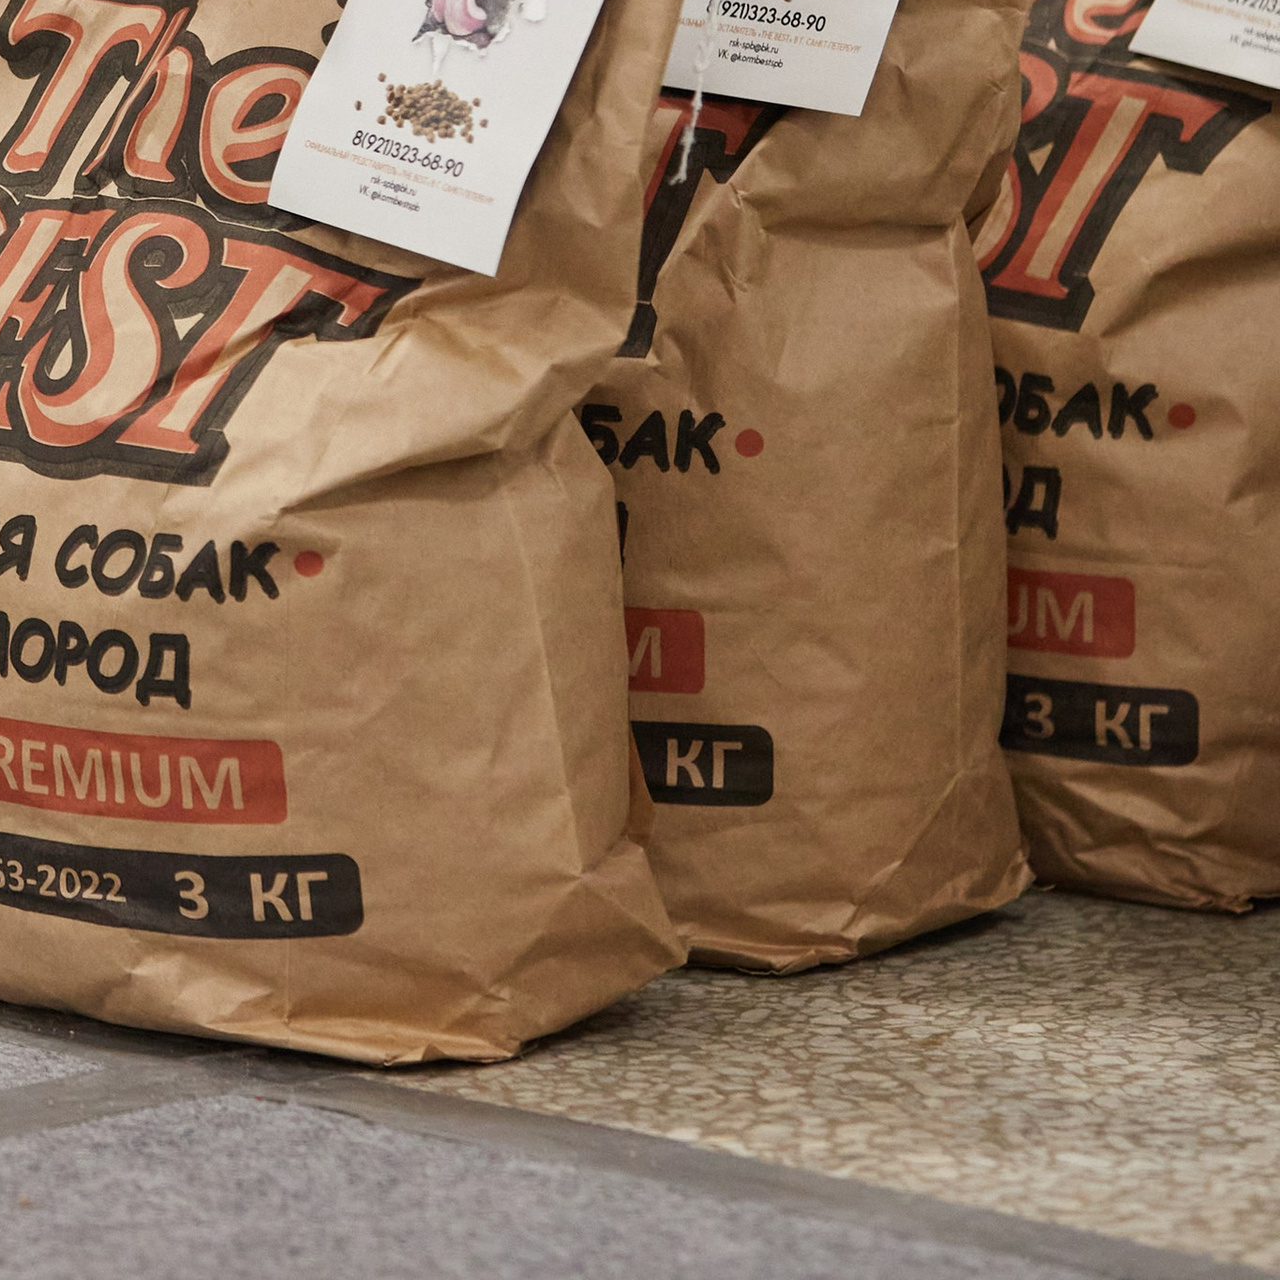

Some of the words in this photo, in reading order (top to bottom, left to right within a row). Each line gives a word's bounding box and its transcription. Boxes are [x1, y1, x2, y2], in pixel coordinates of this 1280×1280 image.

[729, 39, 779, 55] rsk-spb@bk.ru
[730, 51, 784, 69] @kormbestspb
[352, 130, 464, 178] 8(921)323-68-90
[55, 524, 282, 602] СОБАК
[1023, 691, 1055, 741] 3
[1094, 698, 1170, 752] КГ
[665, 737, 743, 789] КГ
[172, 871, 209, 921] 3
[249, 870, 330, 923] КГ
